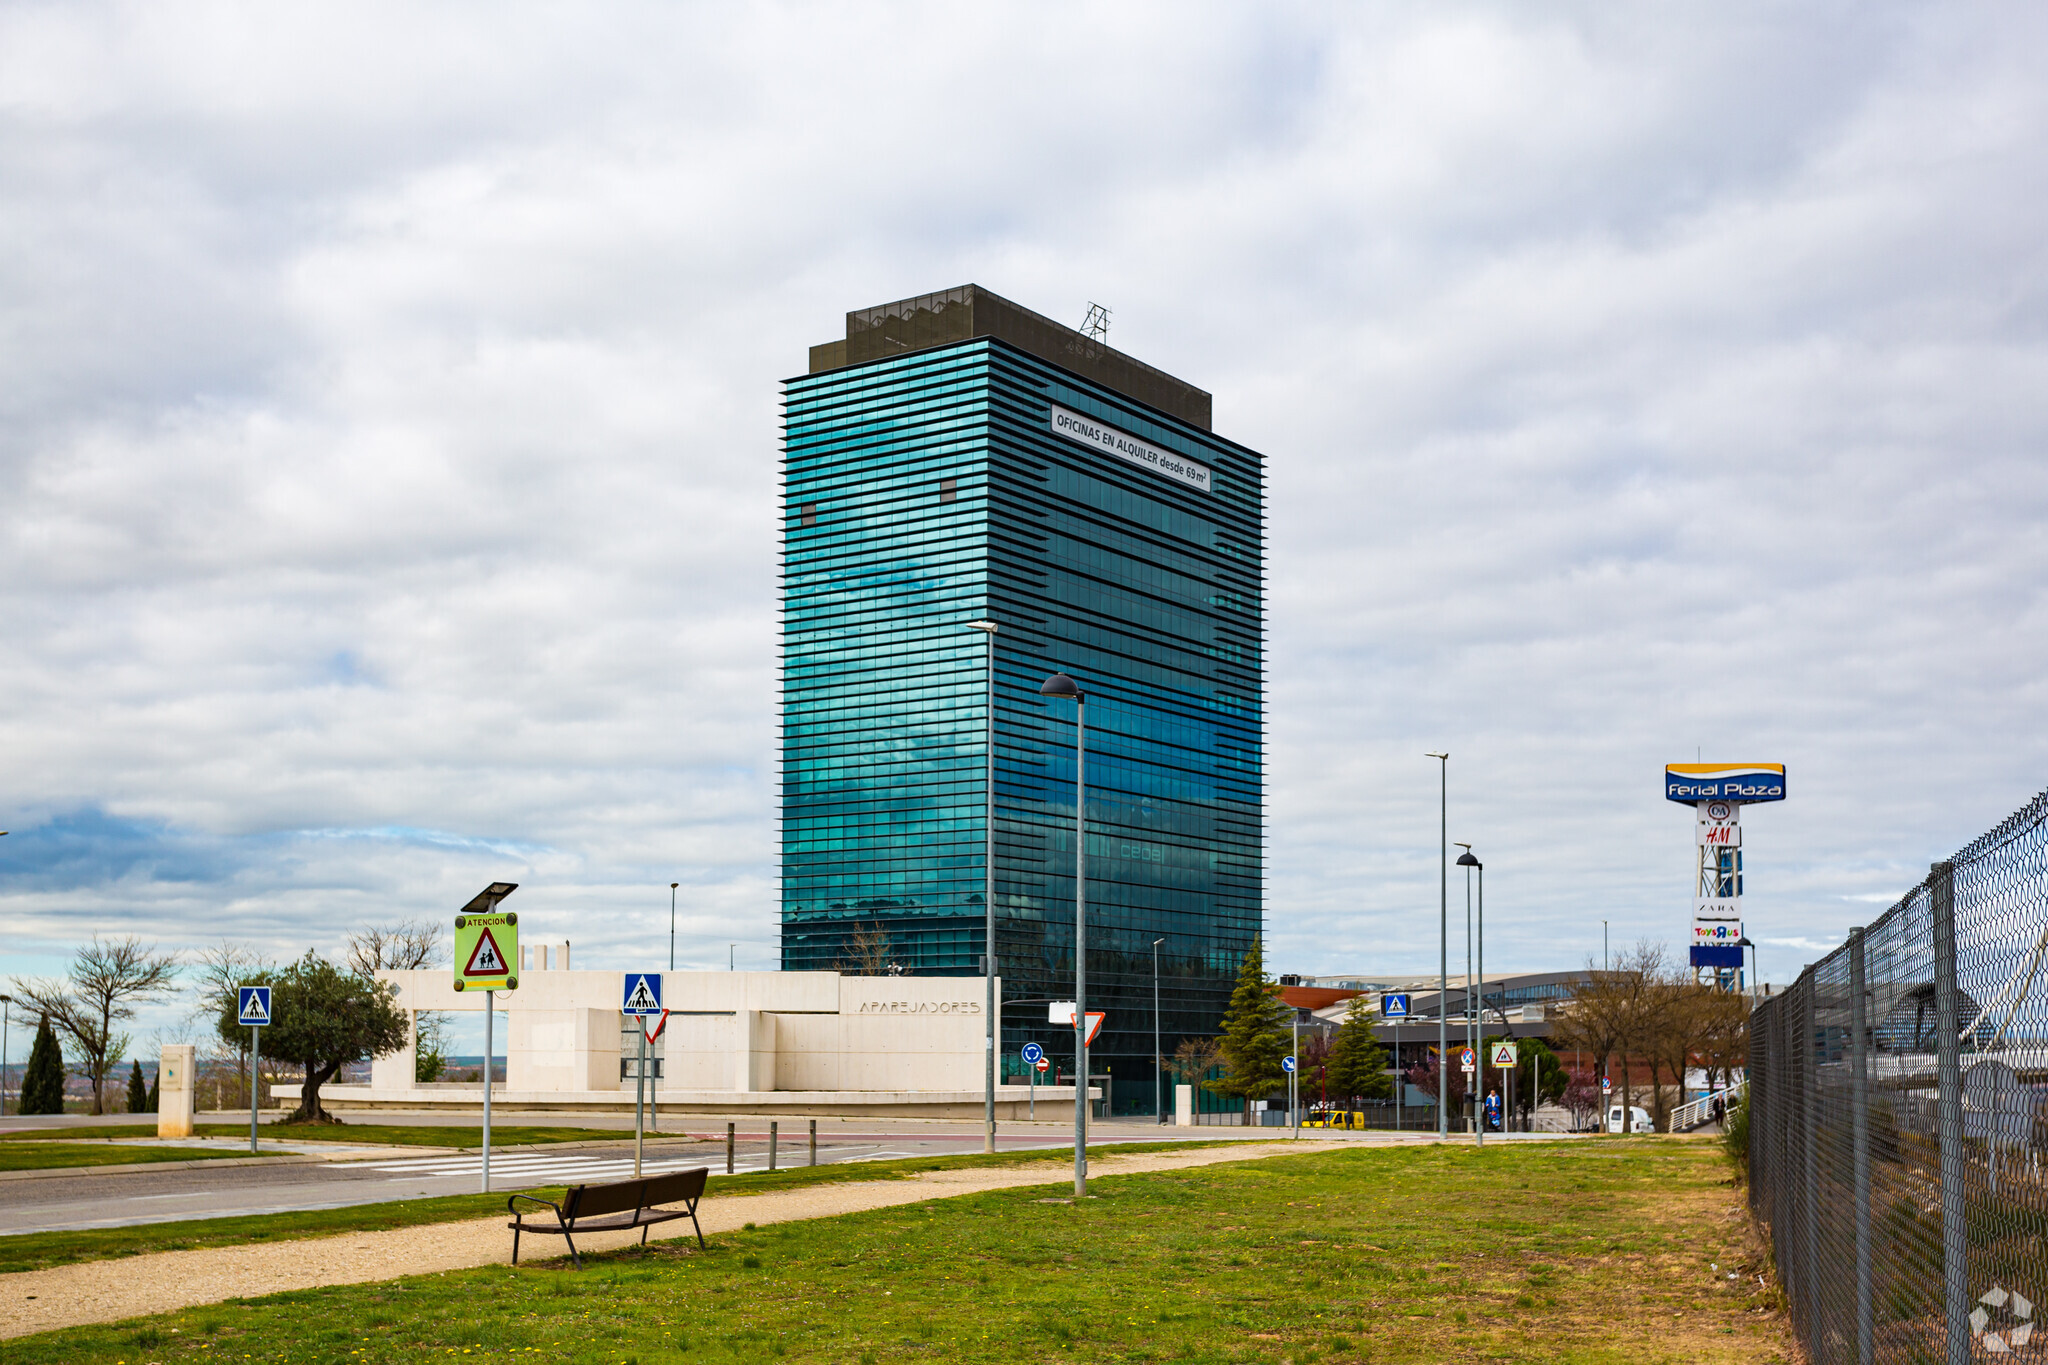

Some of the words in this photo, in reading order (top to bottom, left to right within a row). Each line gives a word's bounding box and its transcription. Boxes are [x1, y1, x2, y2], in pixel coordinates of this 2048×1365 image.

[1057, 414, 1100, 441] OFICINAS
[1102, 432, 1115, 447] EN
[1116, 439, 1158, 464] ALQUILER
[1159, 456, 1185, 475] desde
[1186, 466, 1196, 480] 69
[1669, 783, 1718, 796] Ferial
[1724, 783, 1782, 796] Plaza
[1706, 826, 1731, 844] H&M
[1699, 904, 1735, 912] ZARA
[467, 918, 505, 926] ATENCION
[859, 1002, 981, 1013] APAREJADORES
